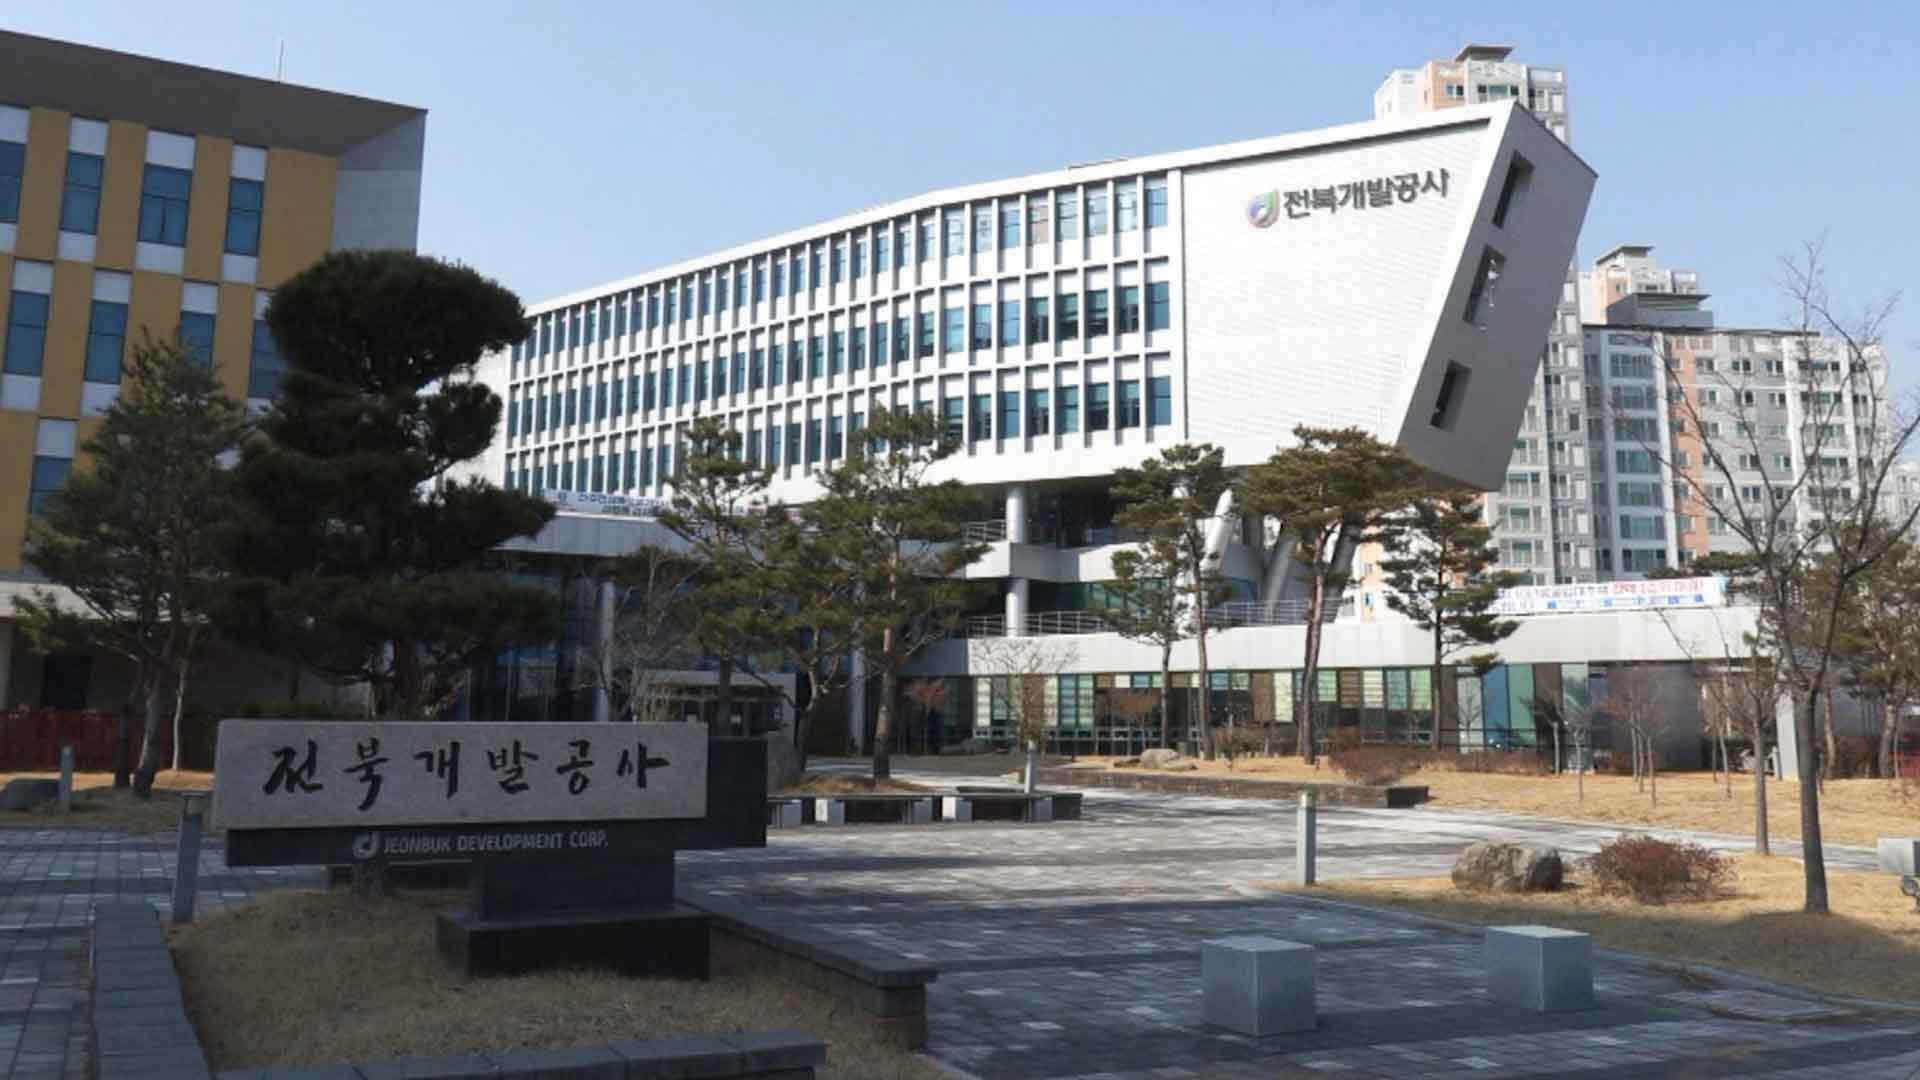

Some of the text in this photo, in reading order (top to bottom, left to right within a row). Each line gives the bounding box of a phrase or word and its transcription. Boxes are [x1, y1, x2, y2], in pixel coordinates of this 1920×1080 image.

[1283, 167, 1450, 219] 전북개발공사
[263, 736, 671, 812] 전북개발공사
[383, 830, 609, 855] JEONBUK DEVELOPMENT CORP.
